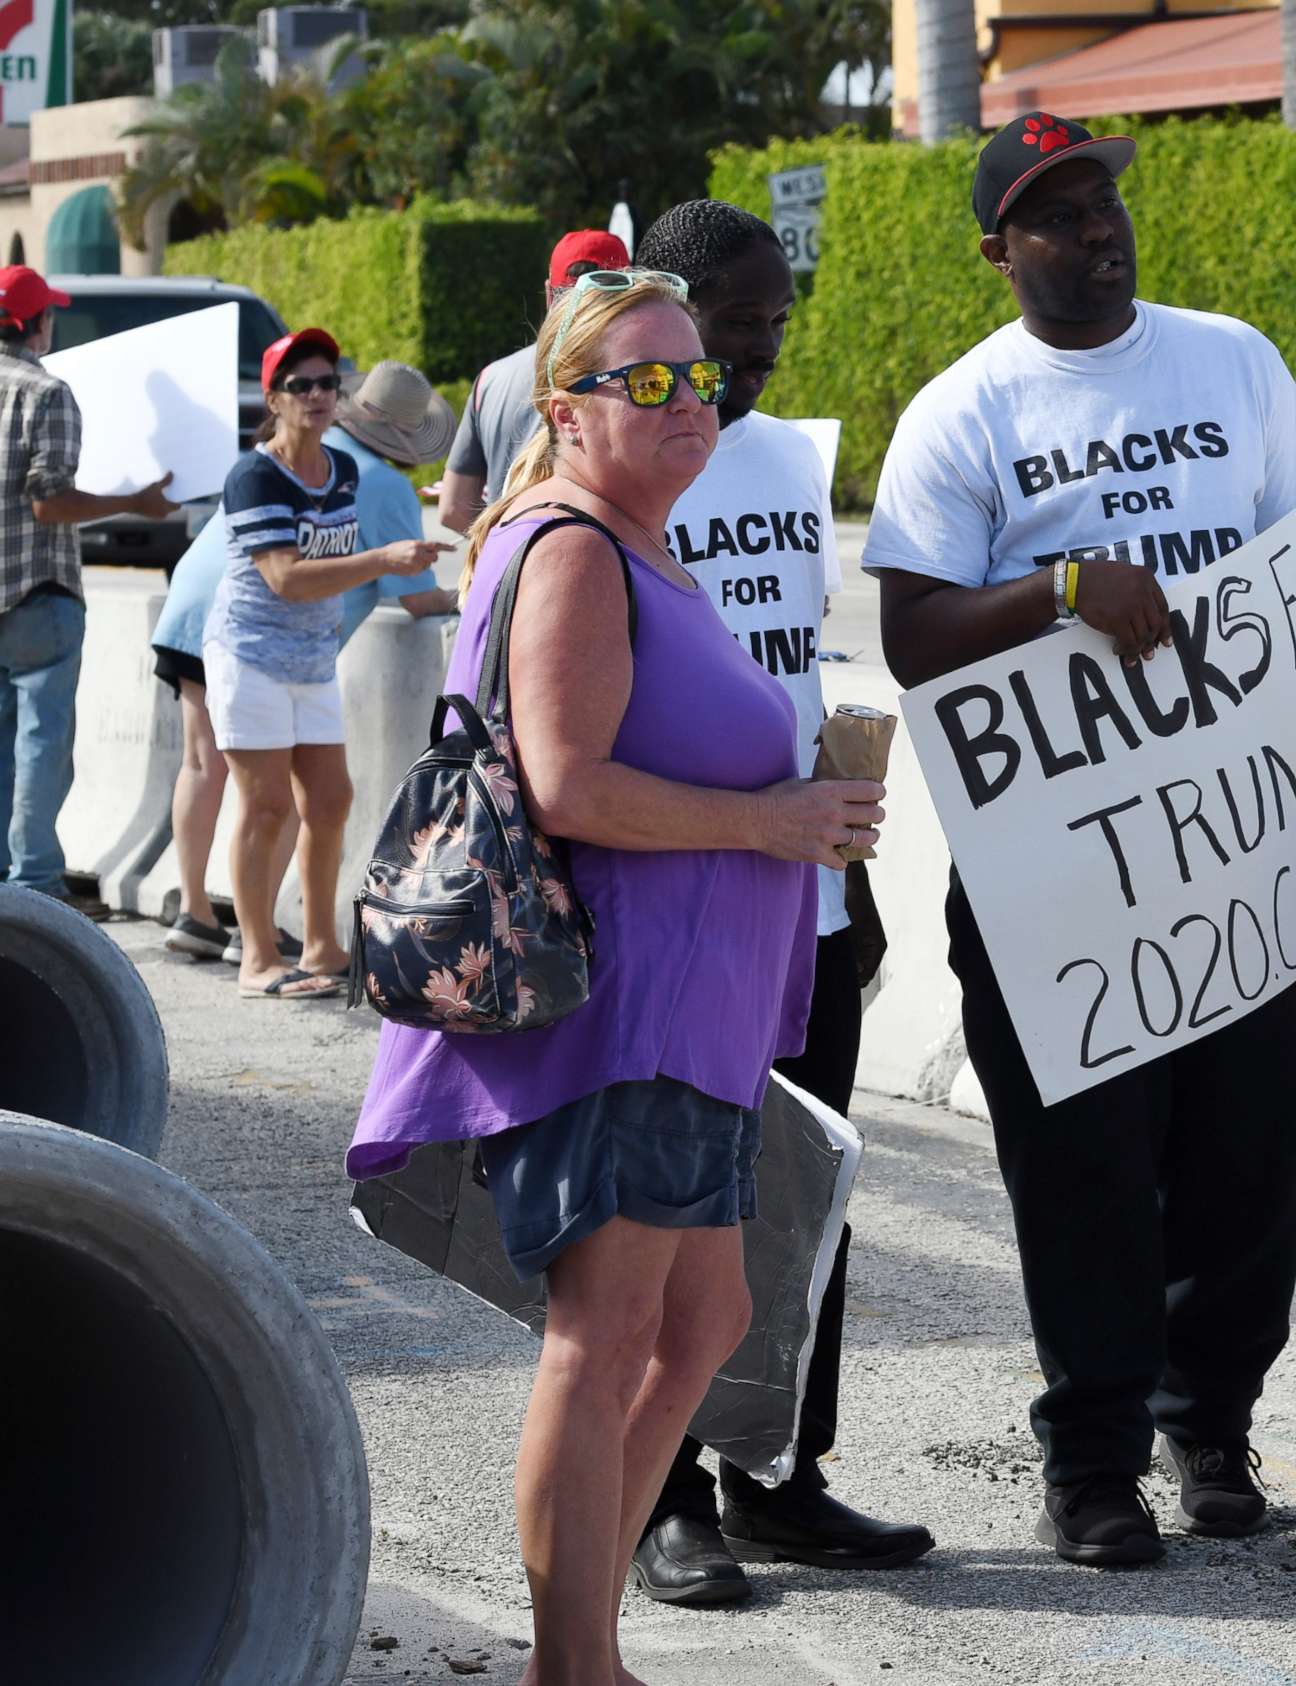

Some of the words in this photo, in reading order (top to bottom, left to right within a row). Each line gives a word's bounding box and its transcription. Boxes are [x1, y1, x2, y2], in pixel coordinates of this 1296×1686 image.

[1012, 421, 1229, 498] BLACKS
[1101, 486, 1174, 519] FOR
[722, 575, 782, 608] FOR
[934, 575, 1272, 810] BLACKS
